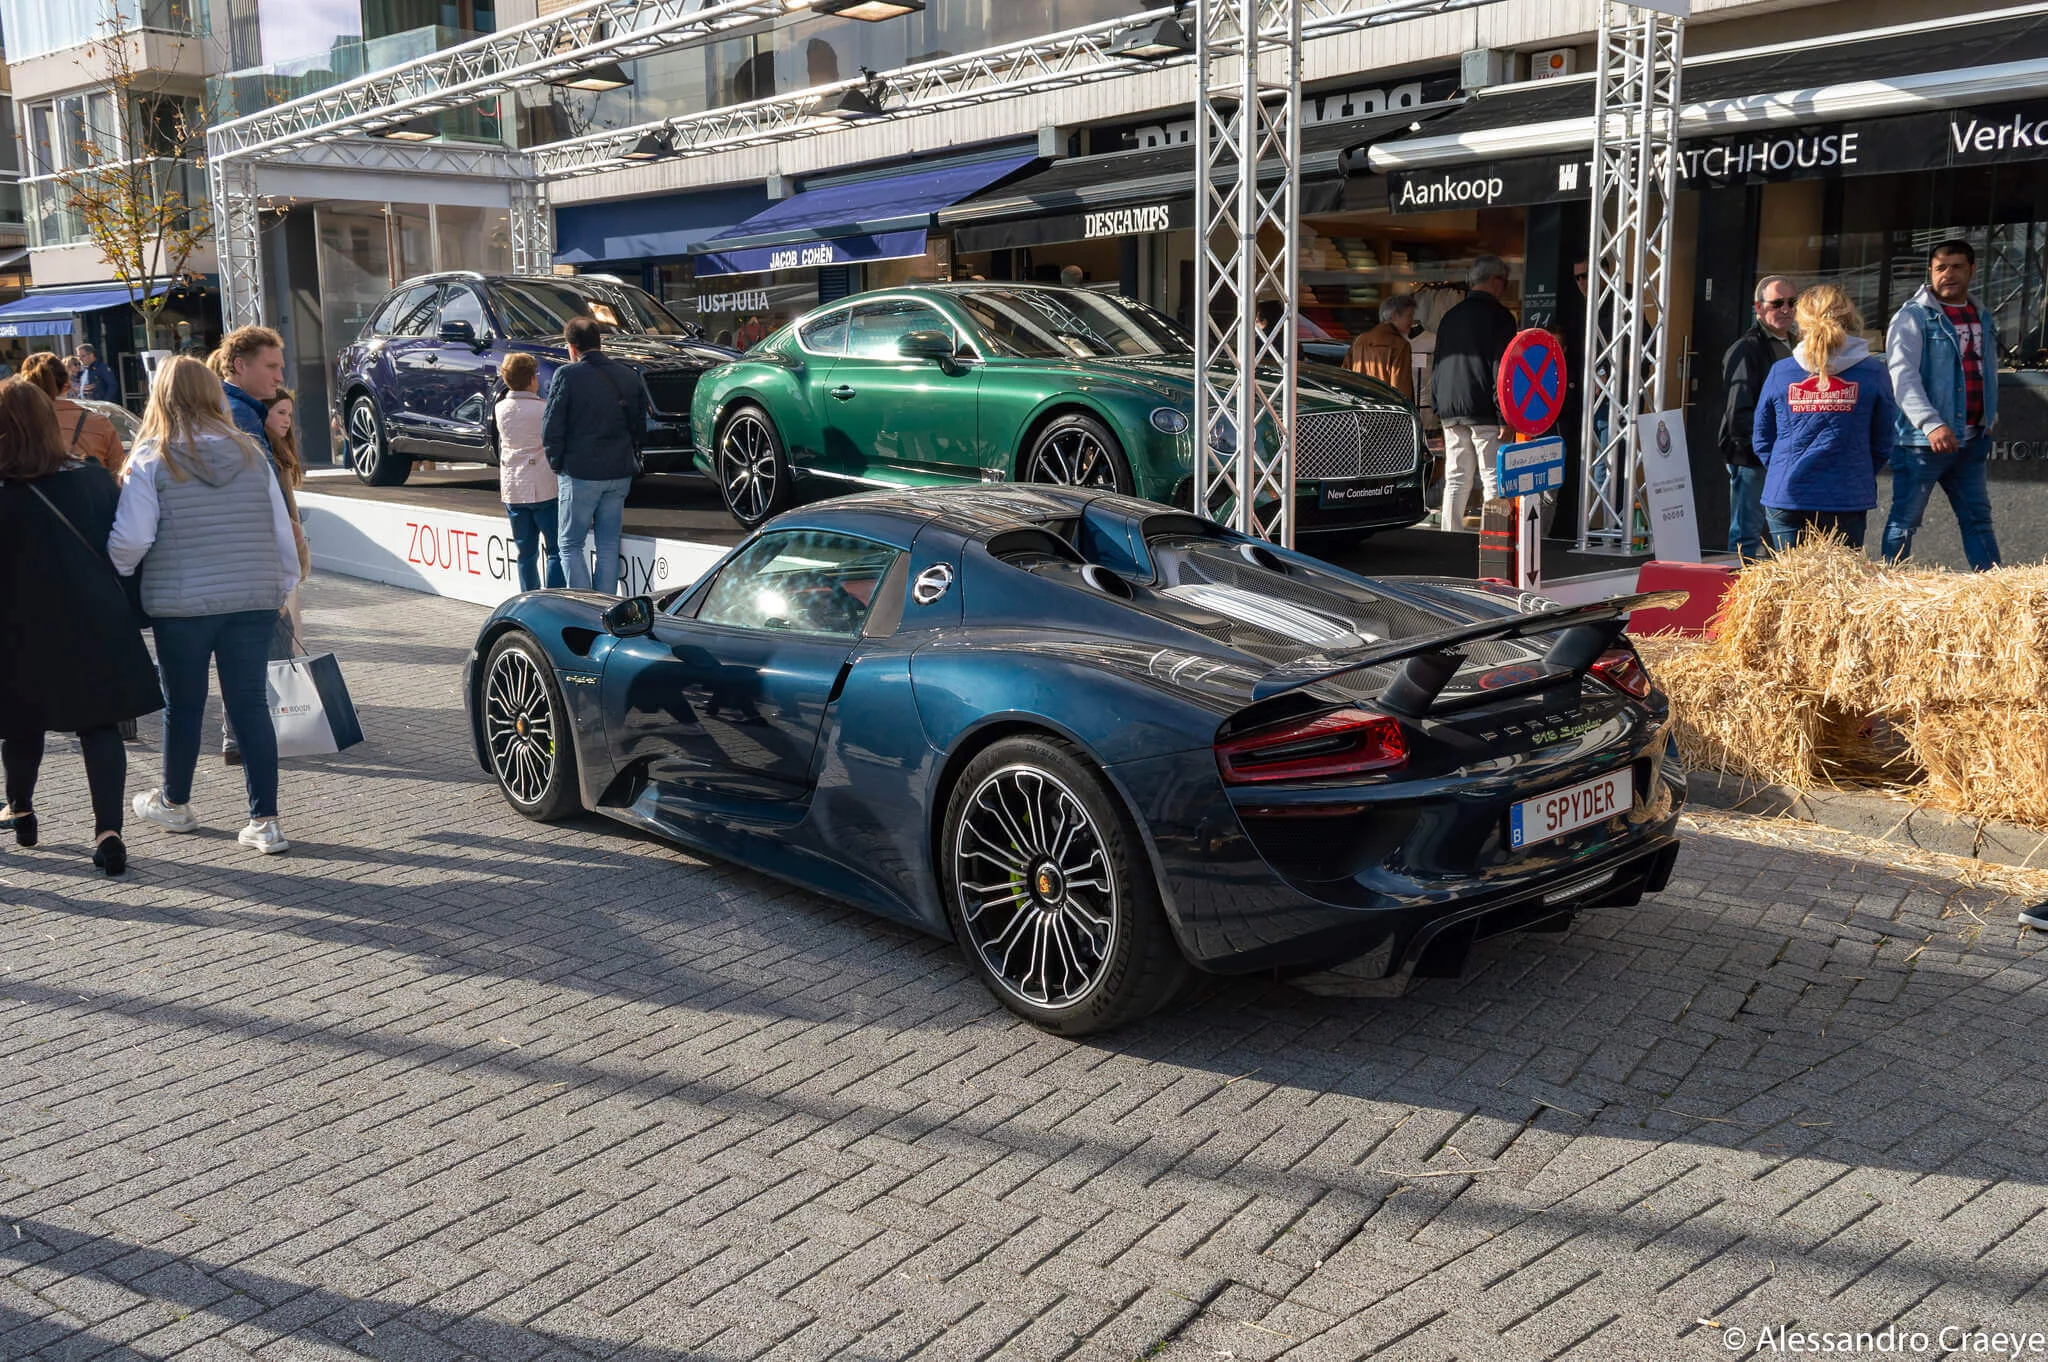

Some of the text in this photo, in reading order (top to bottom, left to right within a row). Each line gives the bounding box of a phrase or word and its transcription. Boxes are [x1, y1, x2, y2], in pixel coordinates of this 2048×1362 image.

[1951, 113, 2048, 153] Verko
[1400, 175, 1503, 205] Aankoop
[1084, 205, 1169, 238] DESCAMPS
[770, 243, 833, 269] JACOB COHËN
[696, 291, 769, 313] JUST JULIA
[1803, 390, 1820, 400] ZOUTE
[1821, 390, 1840, 399] GRAND
[1841, 385, 1855, 399] PRIX
[1792, 404, 1852, 412] RIVER WOODS
[1327, 484, 1395, 499] New Continental GT
[406, 522, 481, 576] ZOUTE
[1559, 719, 1602, 739] Spyder
[1546, 780, 1615, 831] SPYDER
[1513, 828, 1521, 844] B
